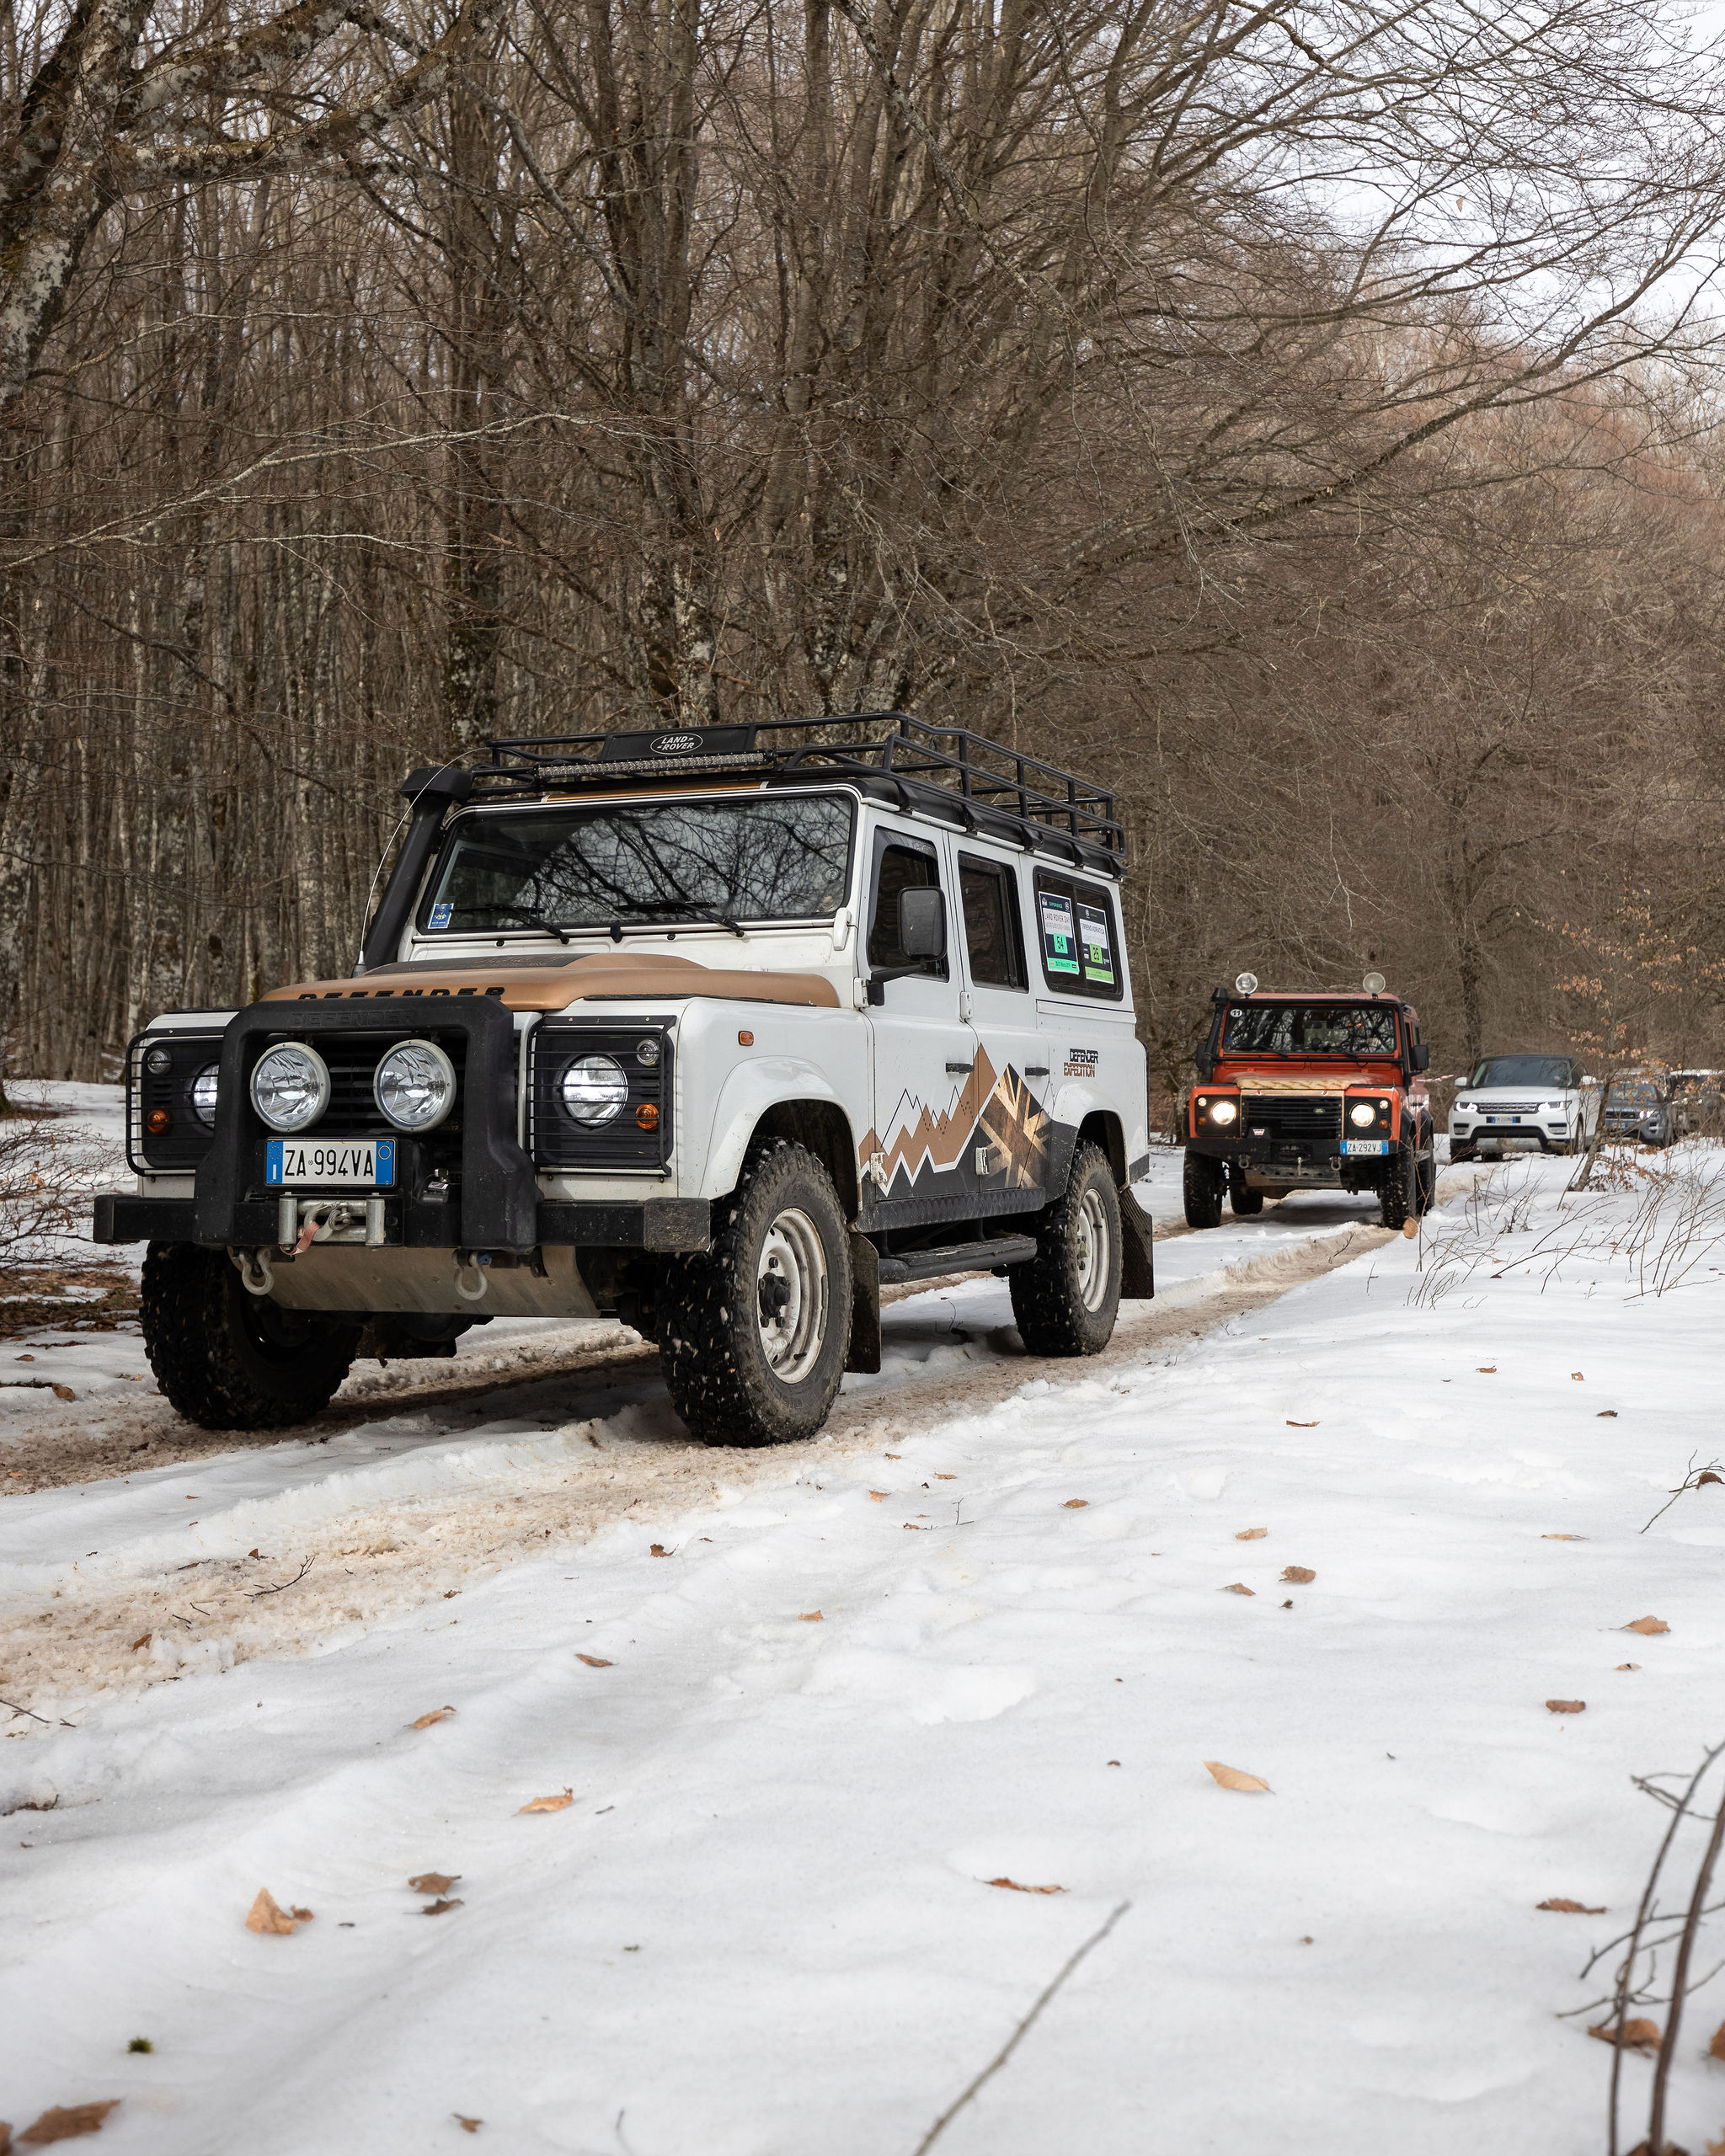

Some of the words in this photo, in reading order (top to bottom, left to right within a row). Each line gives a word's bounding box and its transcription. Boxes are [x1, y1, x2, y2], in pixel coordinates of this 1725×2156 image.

[1056, 936, 1065, 950] 54
[1069, 1048, 1099, 1065] DEFENDER
[1064, 1062, 1096, 1078] EXPEDITION
